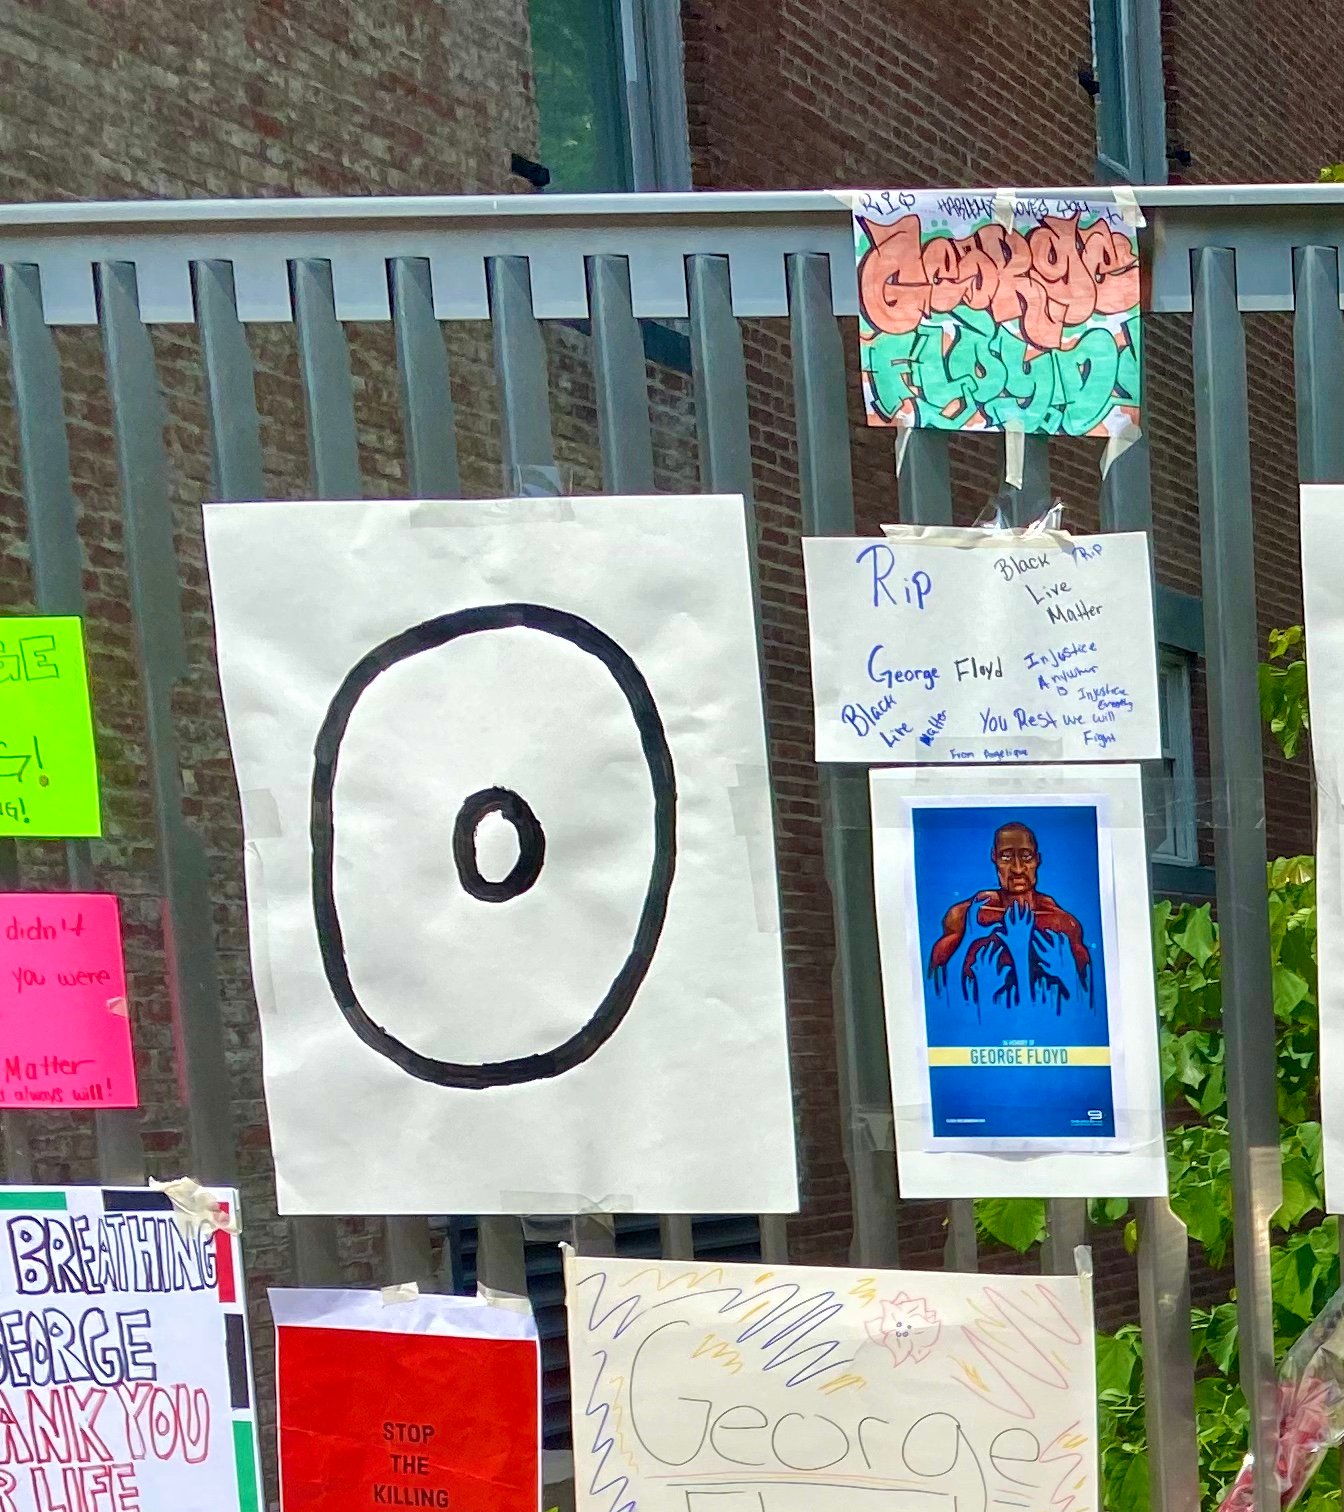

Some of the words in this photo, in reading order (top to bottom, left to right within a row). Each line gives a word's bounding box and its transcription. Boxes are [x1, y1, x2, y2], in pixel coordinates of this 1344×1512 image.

[994, 553, 1050, 581] Black
[1025, 579, 1072, 605] Live
[1047, 603, 1102, 624] Matter
[867, 644, 940, 690] George
[954, 656, 1003, 681] Floyd
[842, 695, 897, 737] Black
[980, 709, 1008, 734] You
[1013, 707, 1058, 731] Rest
[1063, 714, 1086, 726] we
[1092, 711, 1115, 723] will
[311, 603, 677, 1089] O
[6, 913, 87, 941] didn't
[12, 970, 46, 994] you
[57, 970, 111, 988] were
[5, 1055, 96, 1083] Matter
[971, 1049, 1023, 1064] GEORGE
[1028, 1049, 1068, 1064] FLOYD
[14, 1086, 64, 1103] always
[72, 1077, 112, 1100] will!
[7, 1213, 219, 1296] BREATHING
[0, 1307, 157, 1388] EORGE
[113, 1383, 210, 1464] YOU
[382, 1421, 435, 1444] STOP
[390, 1453, 429, 1475] THE
[373, 1484, 449, 1508] KILLING
